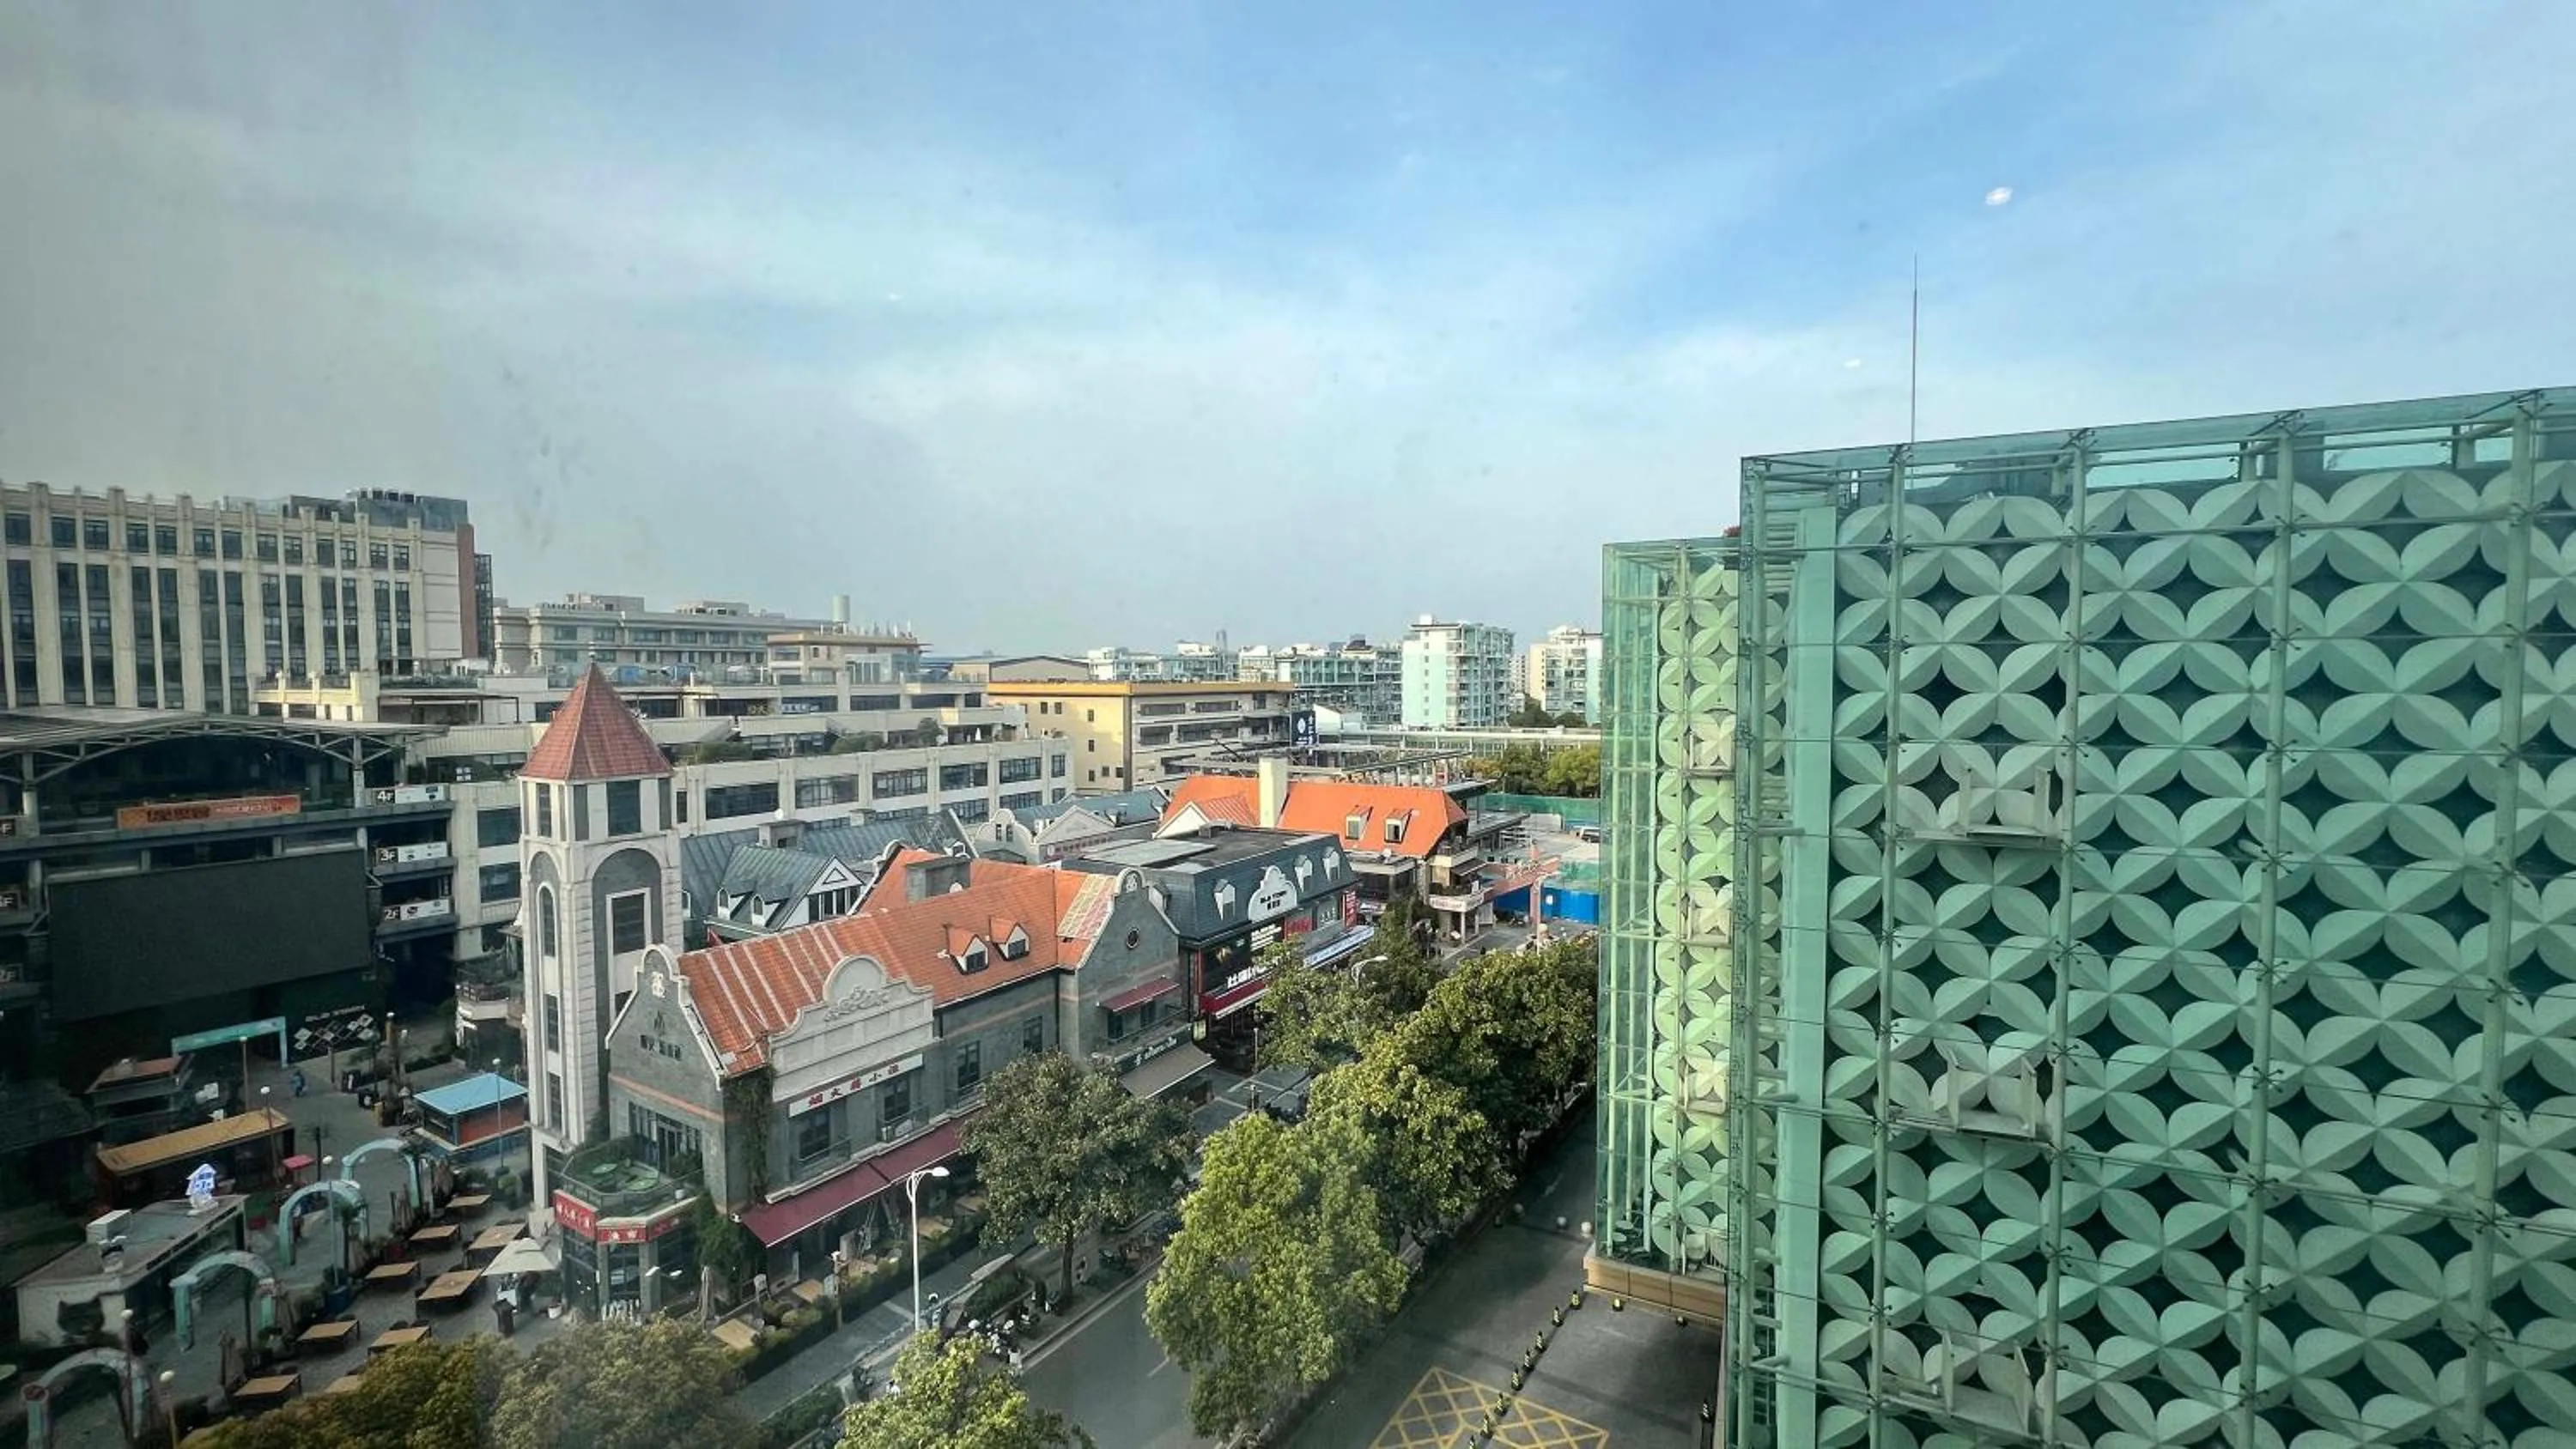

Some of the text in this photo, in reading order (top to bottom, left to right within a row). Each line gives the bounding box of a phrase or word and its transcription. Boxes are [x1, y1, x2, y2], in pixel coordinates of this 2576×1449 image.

[377, 791, 393, 803] 4F
[380, 850, 397, 862] 3F
[385, 909, 399, 920] 2F
